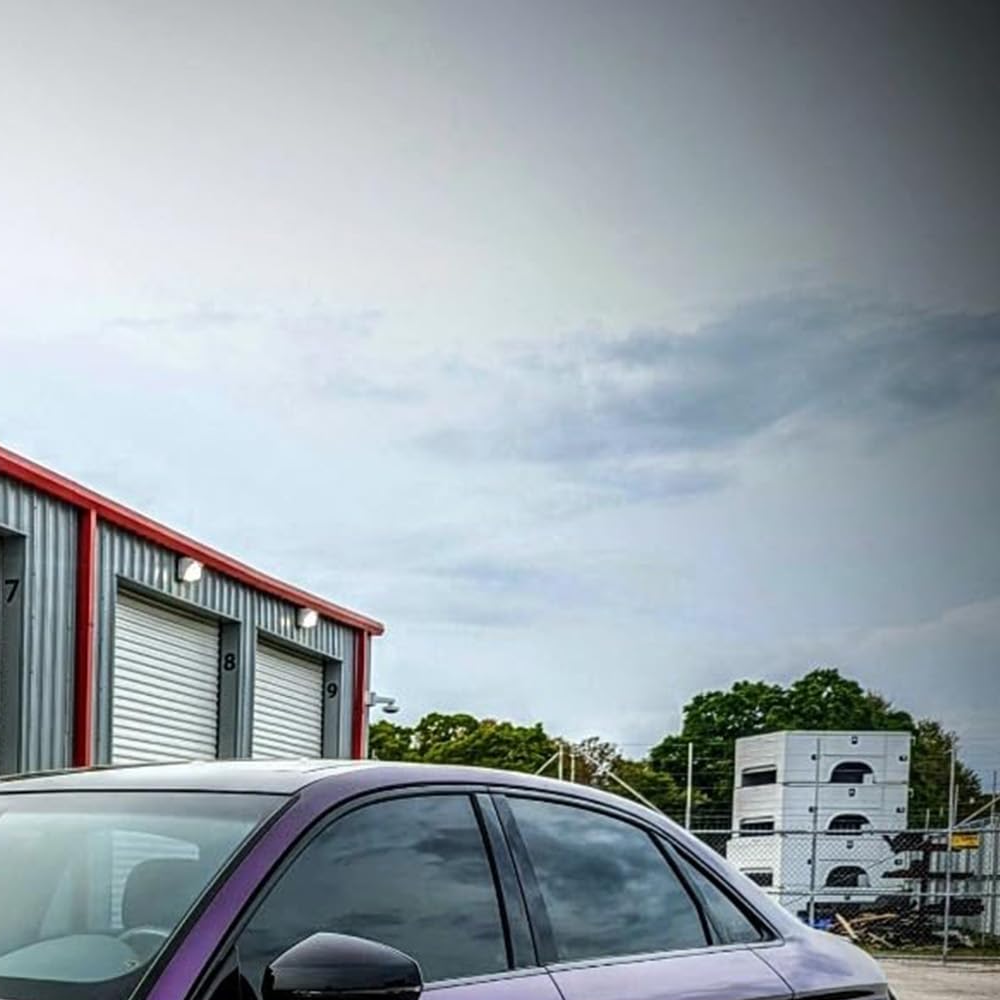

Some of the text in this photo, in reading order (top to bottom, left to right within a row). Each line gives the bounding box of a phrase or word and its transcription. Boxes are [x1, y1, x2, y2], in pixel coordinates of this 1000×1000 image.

[5, 579, 19, 603] 7
[223, 653, 236, 671] 8
[326, 683, 338, 699] 9
